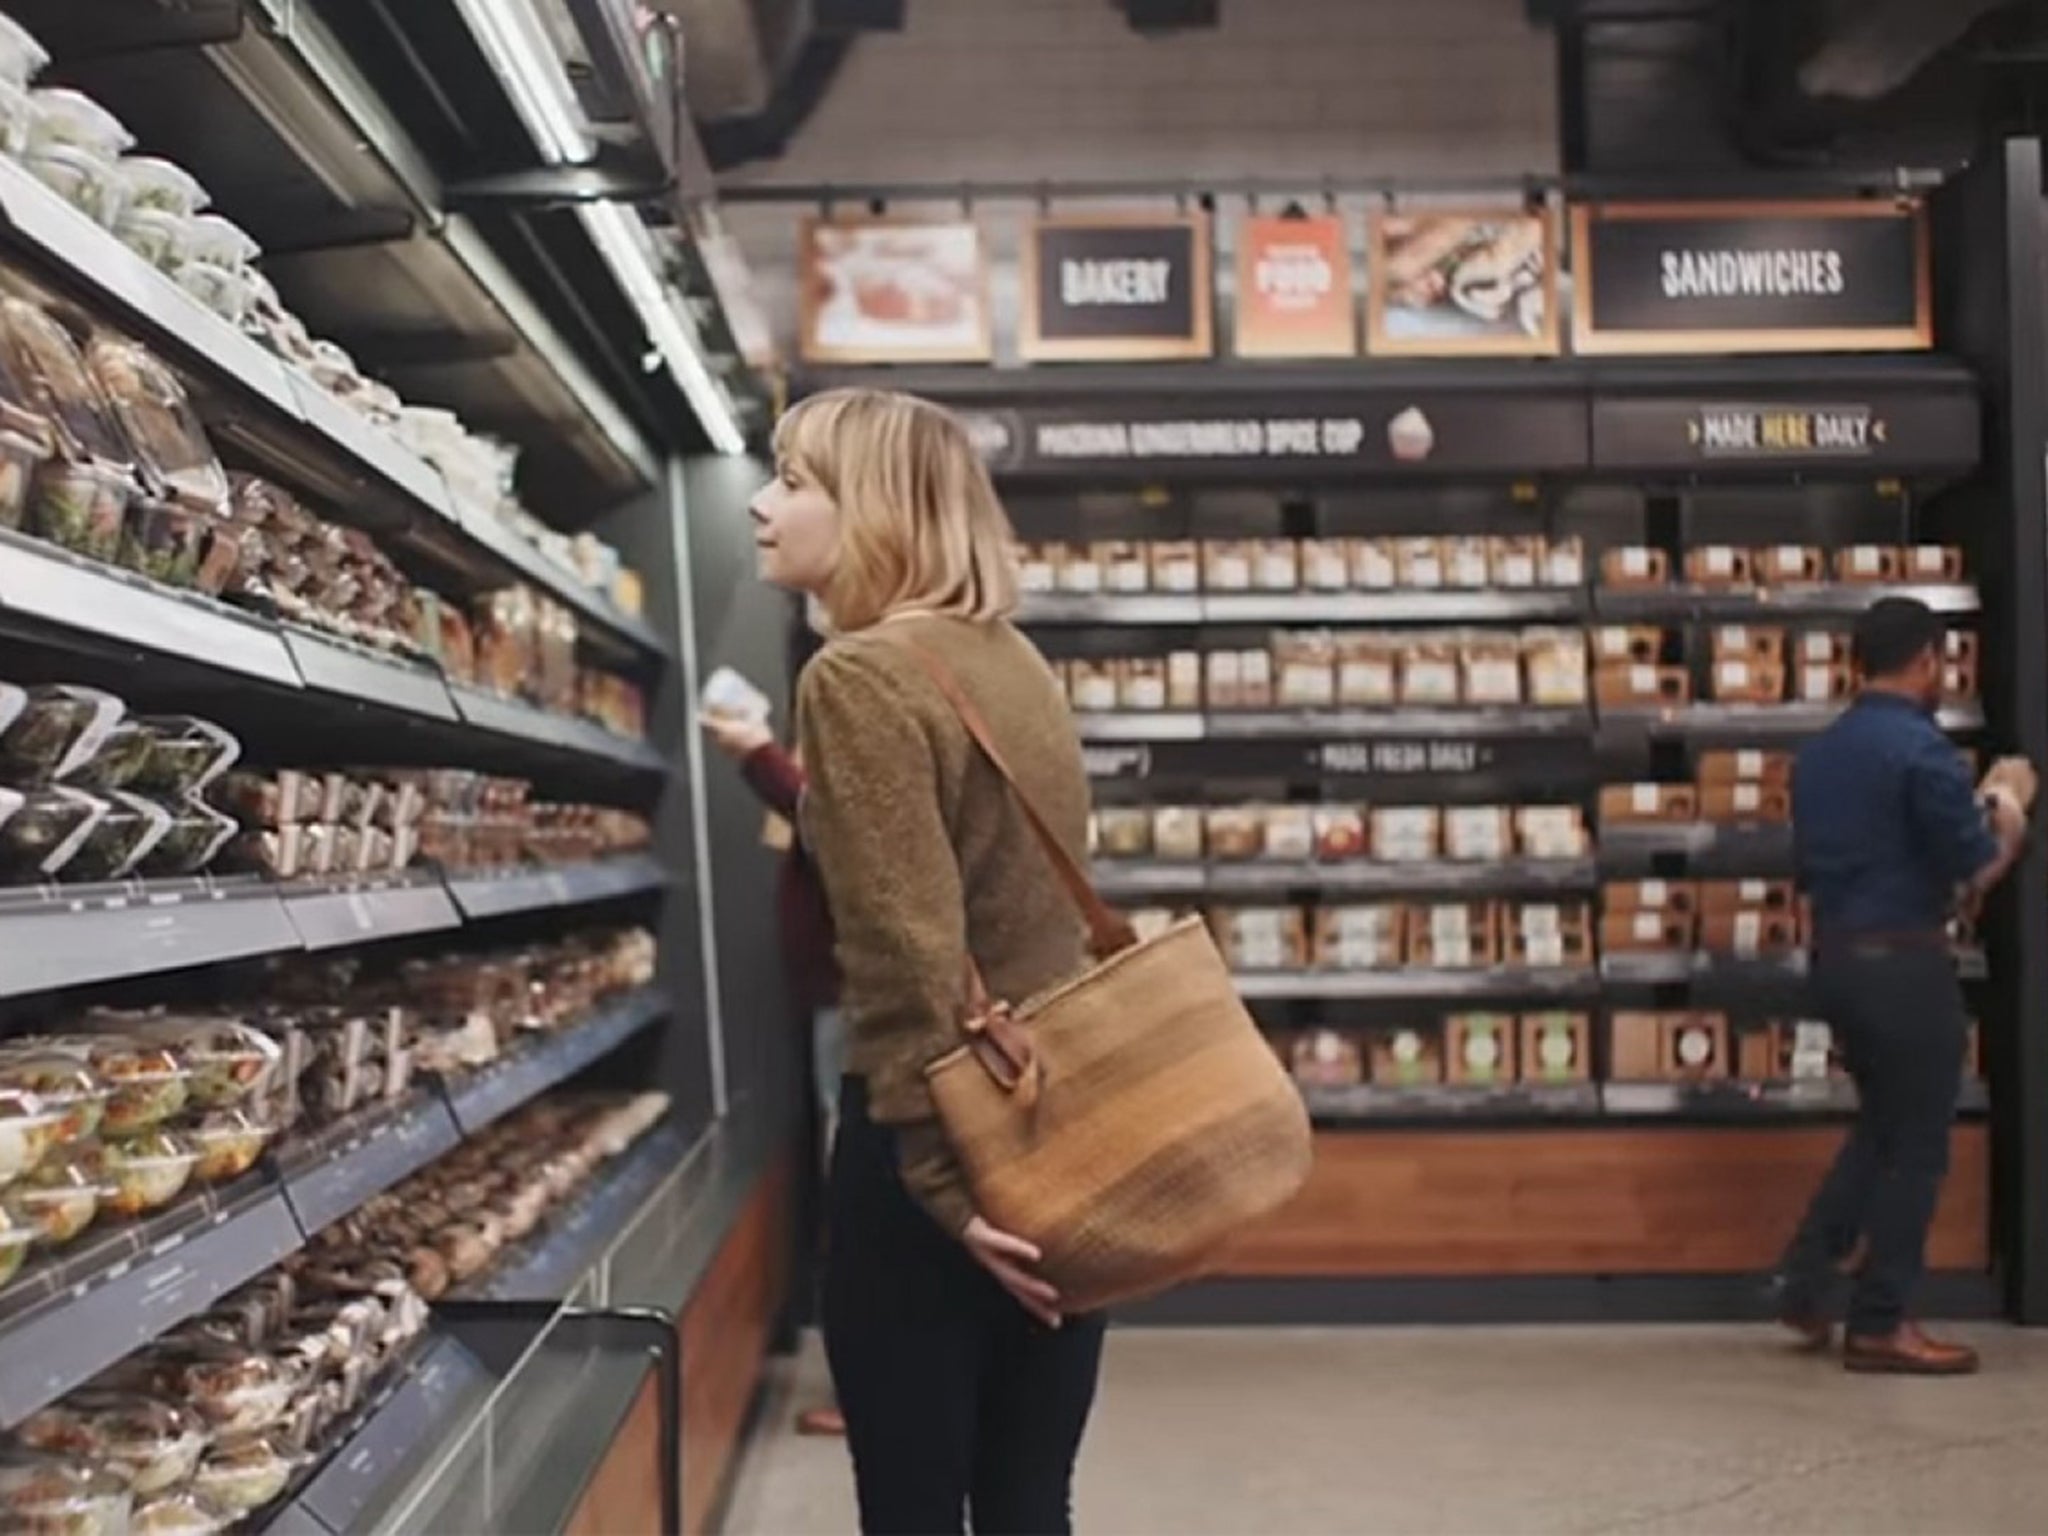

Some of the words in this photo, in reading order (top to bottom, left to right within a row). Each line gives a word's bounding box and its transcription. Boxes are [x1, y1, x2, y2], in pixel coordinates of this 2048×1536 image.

[1061, 257, 1171, 305] BAKERY
[1661, 249, 1844, 297] SANDWICHES
[1704, 412, 1756, 448] MADE
[1762, 412, 1811, 448] HERE
[1815, 411, 1870, 447] DAILY
[1428, 742, 1476, 771] DAILY
